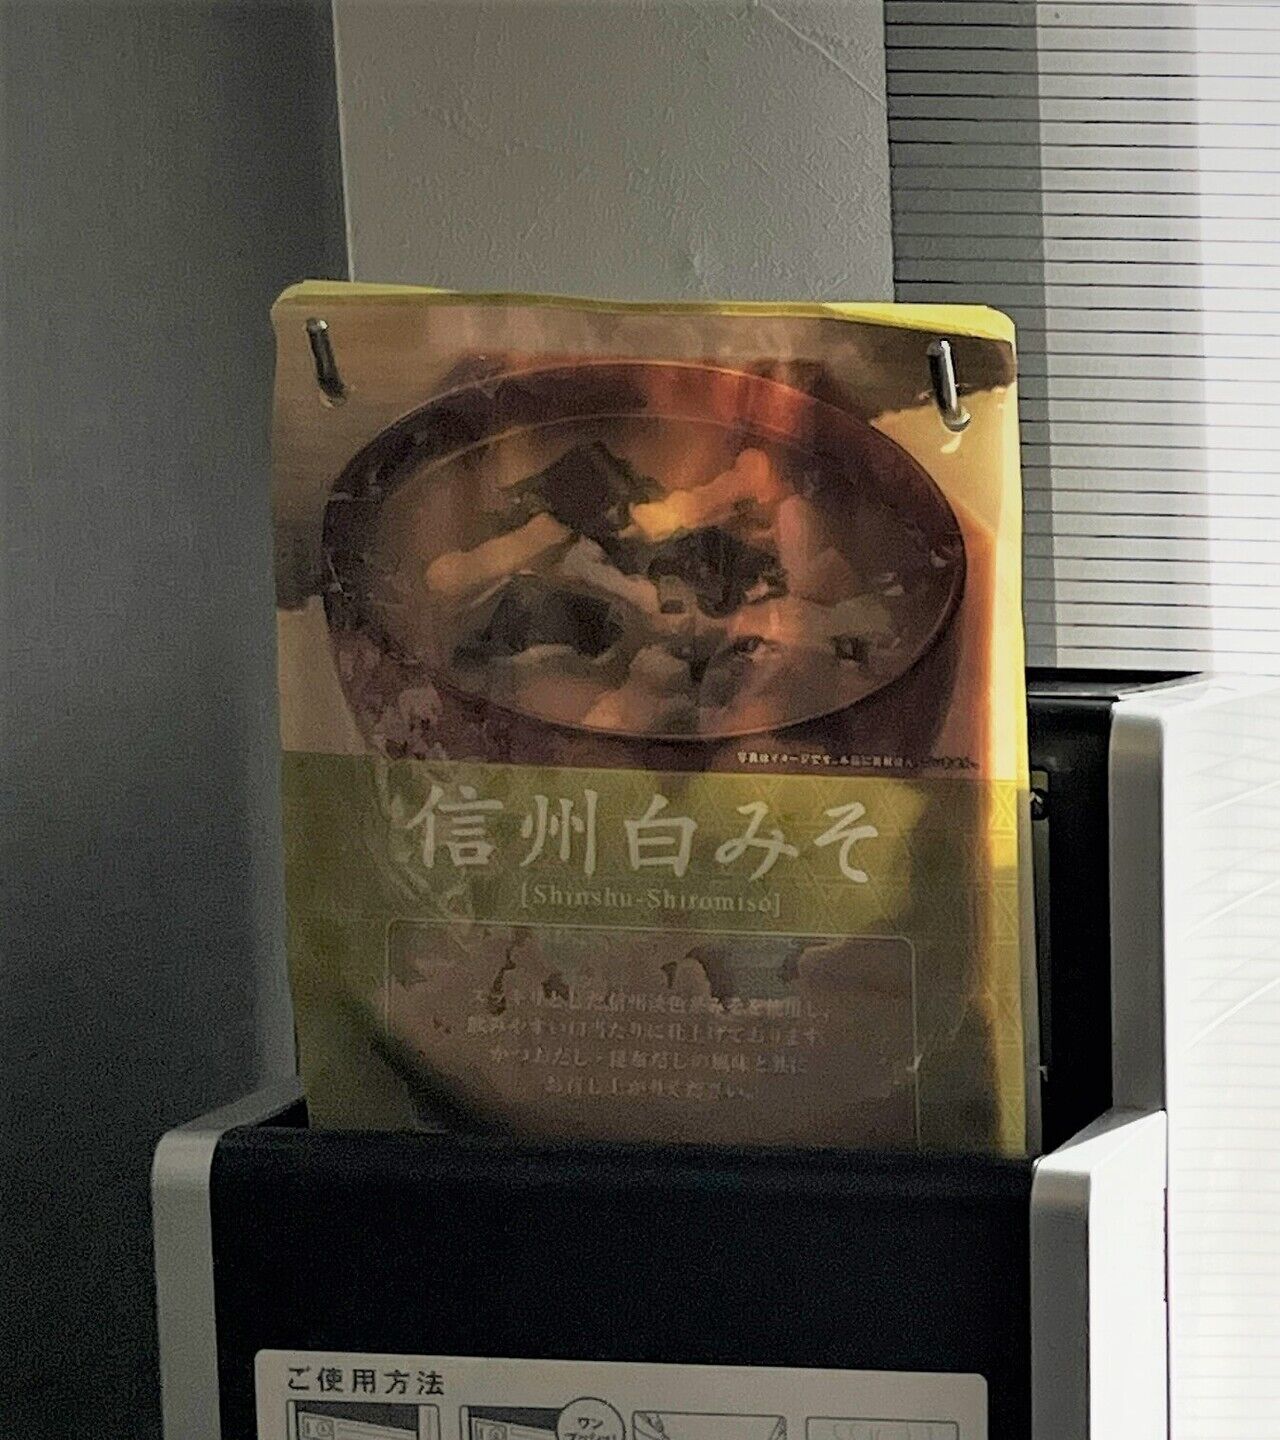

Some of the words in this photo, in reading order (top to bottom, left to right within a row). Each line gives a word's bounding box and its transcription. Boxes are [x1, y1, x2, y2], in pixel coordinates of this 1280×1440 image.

[406, 785, 879, 882] 信州白みそ
[287, 1366, 445, 1396] ご使用方法
[576, 1416, 604, 1430] ワン
